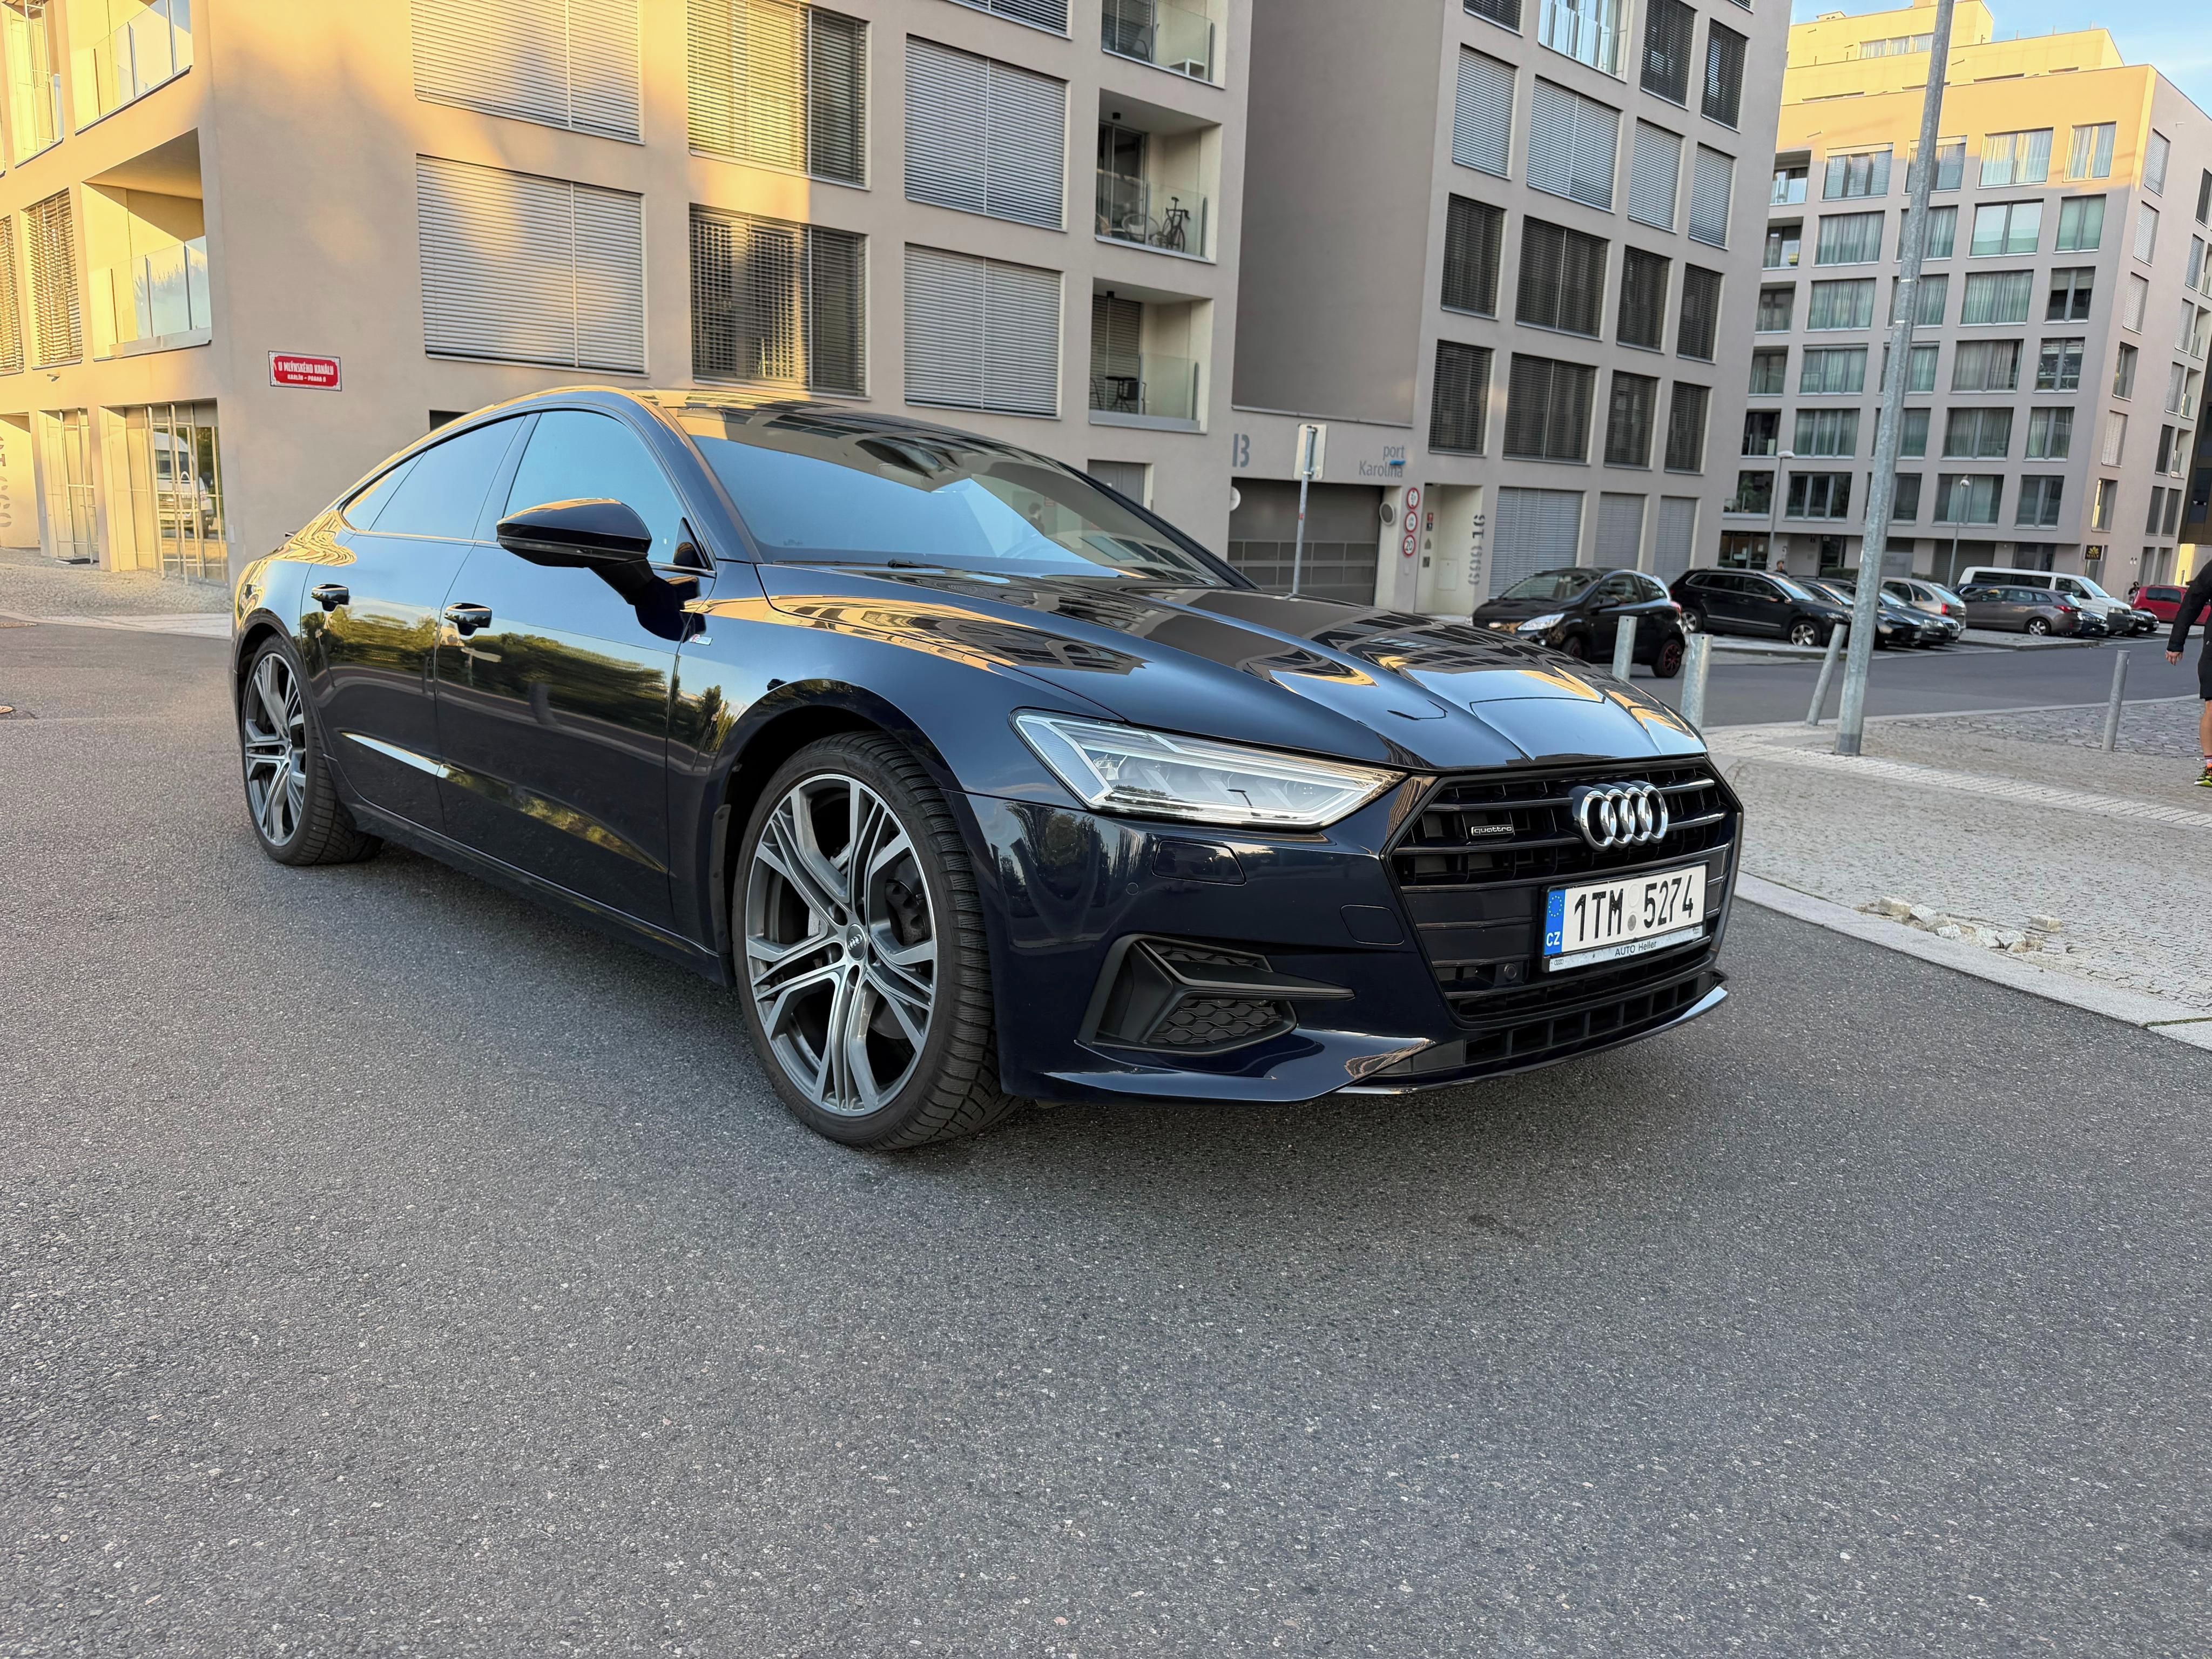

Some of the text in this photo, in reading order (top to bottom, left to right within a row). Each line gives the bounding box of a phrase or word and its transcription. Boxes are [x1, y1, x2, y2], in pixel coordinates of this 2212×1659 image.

[278, 361, 282, 372] U
[314, 363, 334, 375] KANÁLU
[1382, 445, 1405, 461] port
[1405, 540, 1413, 551] 20
[1474, 826, 1512, 834] quattro
[1574, 875, 1694, 942] 1TM 5274
[1546, 931, 1561, 947] CZ
[1615, 941, 1657, 957] AUTO Heller
